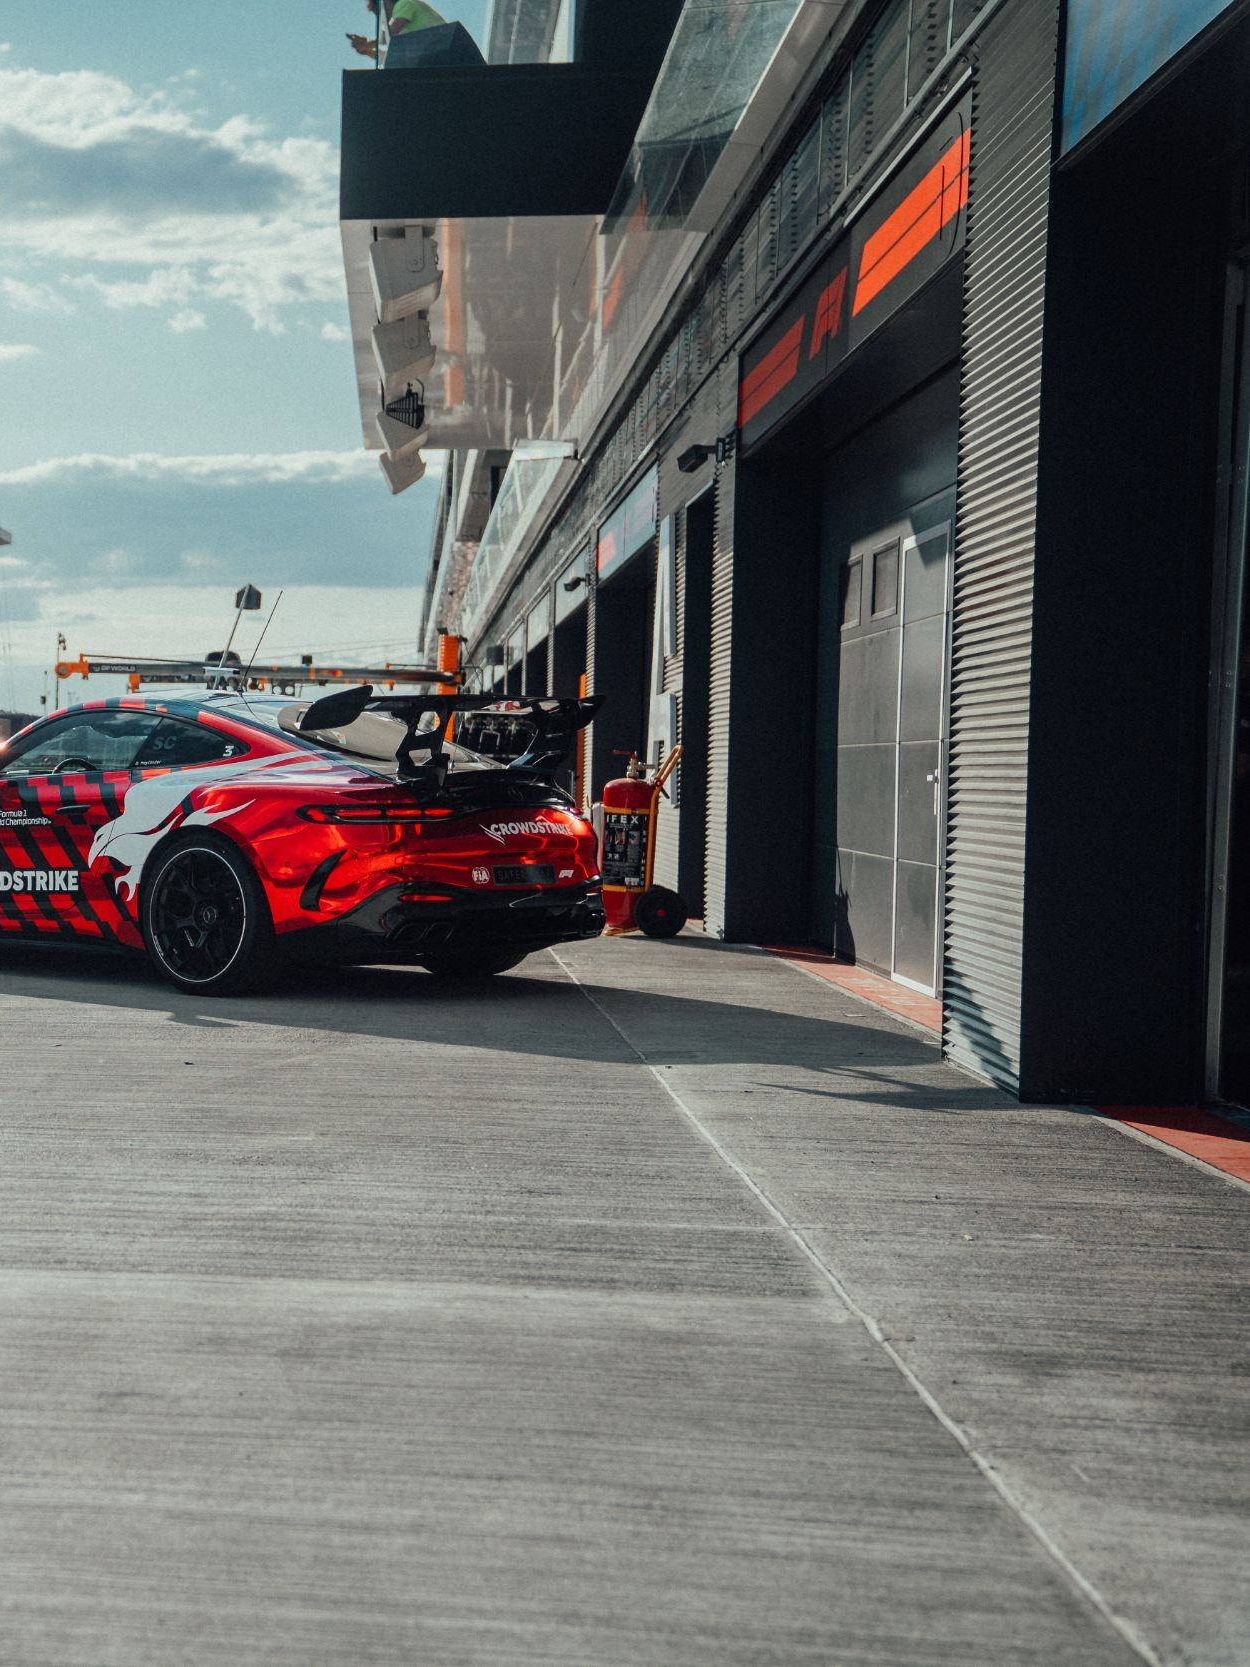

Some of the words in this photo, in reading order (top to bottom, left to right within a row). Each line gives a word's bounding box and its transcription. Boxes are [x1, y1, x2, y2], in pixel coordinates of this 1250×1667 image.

[111, 664, 135, 672] WORLD
[152, 736, 177, 750] SC
[222, 745, 234, 757] 3
[23, 809, 27, 817] 1
[6, 817, 48, 827] Championship
[490, 821, 573, 836] CROWDSTRIKE
[472, 869, 489, 882] FIA
